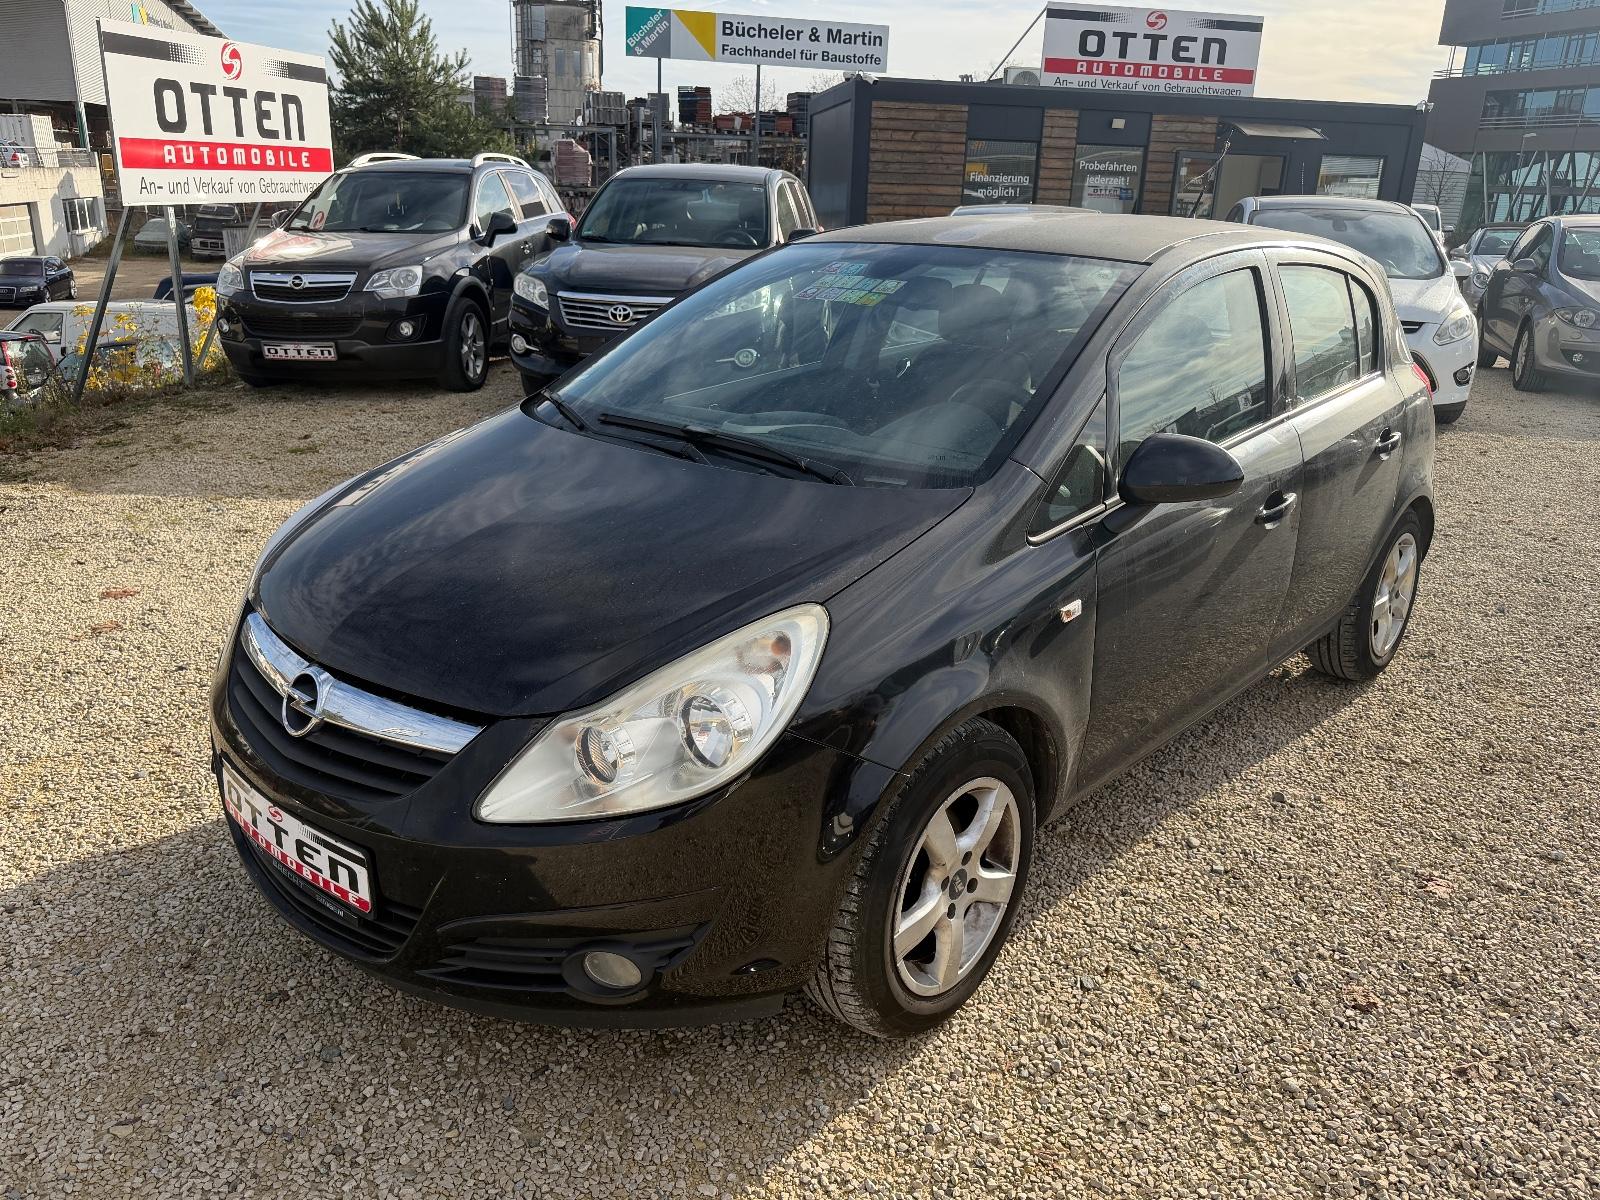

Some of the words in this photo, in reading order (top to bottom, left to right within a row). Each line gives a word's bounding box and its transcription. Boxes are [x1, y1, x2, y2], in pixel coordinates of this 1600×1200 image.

[627, 10, 663, 47] Bücheler
[635, 46, 644, 55] &
[641, 20, 669, 48] Martin
[722, 21, 804, 41] Bücheler
[809, 27, 821, 43] &
[827, 28, 883, 47] Martin
[722, 44, 796, 60] Fachhandel
[800, 49, 818, 61] für
[821, 51, 881, 66] Baustoffe
[1078, 29, 1228, 65] OTTEN
[1076, 61, 1224, 81] AUTOMOBILE
[1053, 76, 1074, 87] An-
[1077, 79, 1097, 88] und
[1100, 79, 1139, 90] Verkauf
[1142, 83, 1160, 92] von
[1164, 82, 1242, 96] Gebrauchtwagen
[153, 78, 306, 141] OTTEN
[163, 145, 310, 168] AUTOMOBILE
[1079, 160, 1137, 172] Probefahrten
[139, 176, 163, 195] An-
[168, 177, 190, 195] und
[193, 177, 234, 195] Verkauf
[238, 182, 256, 194] von
[969, 171, 1030, 186] Finanzierung
[267, 347, 333, 357] OTTEN
[226, 779, 360, 894] OTTEN
[230, 804, 360, 907] AUTOMOBILE
